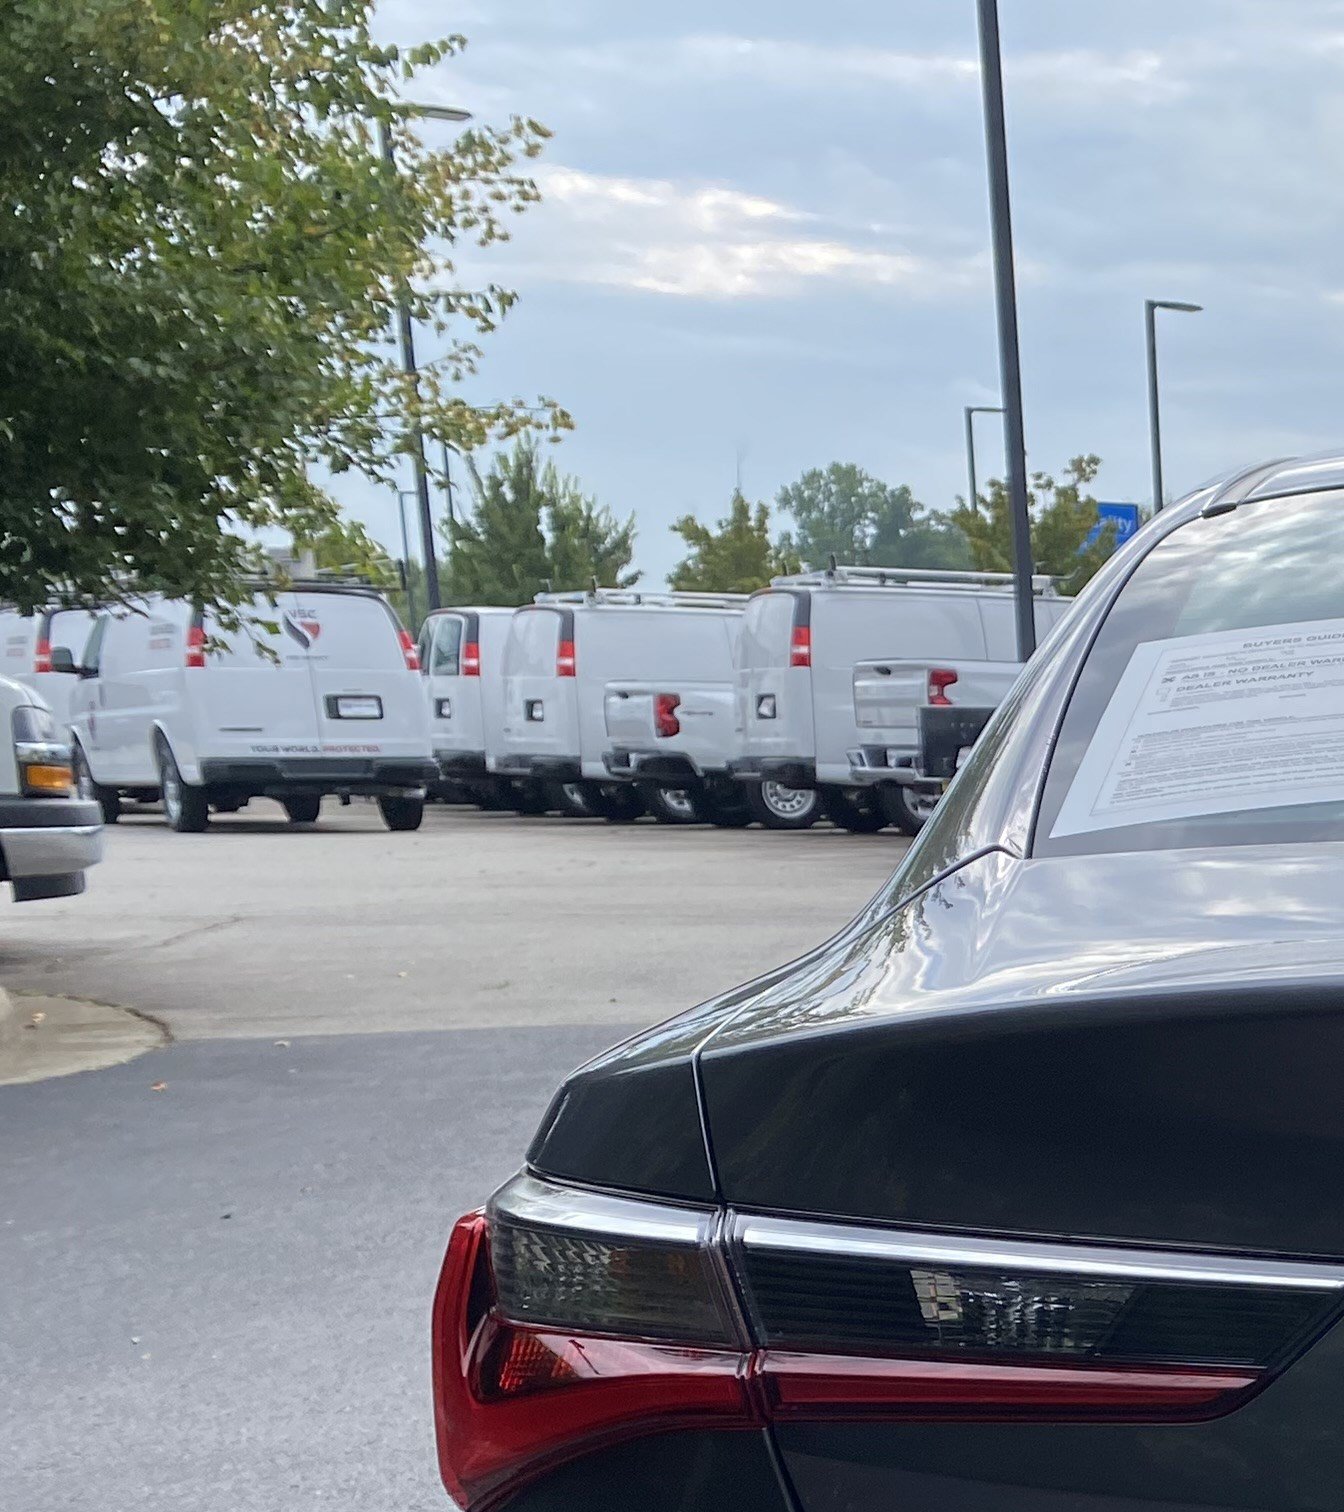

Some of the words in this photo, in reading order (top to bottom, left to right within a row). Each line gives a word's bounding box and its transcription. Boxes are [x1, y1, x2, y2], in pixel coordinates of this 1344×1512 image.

[1242, 637, 1302, 649] BUYERS
[1181, 673, 1200, 681] AS
[1228, 666, 1249, 674] NO
[1252, 660, 1306, 671] DEALER
[1176, 680, 1231, 692] DEALER
[1235, 671, 1314, 684] WARRANTY
